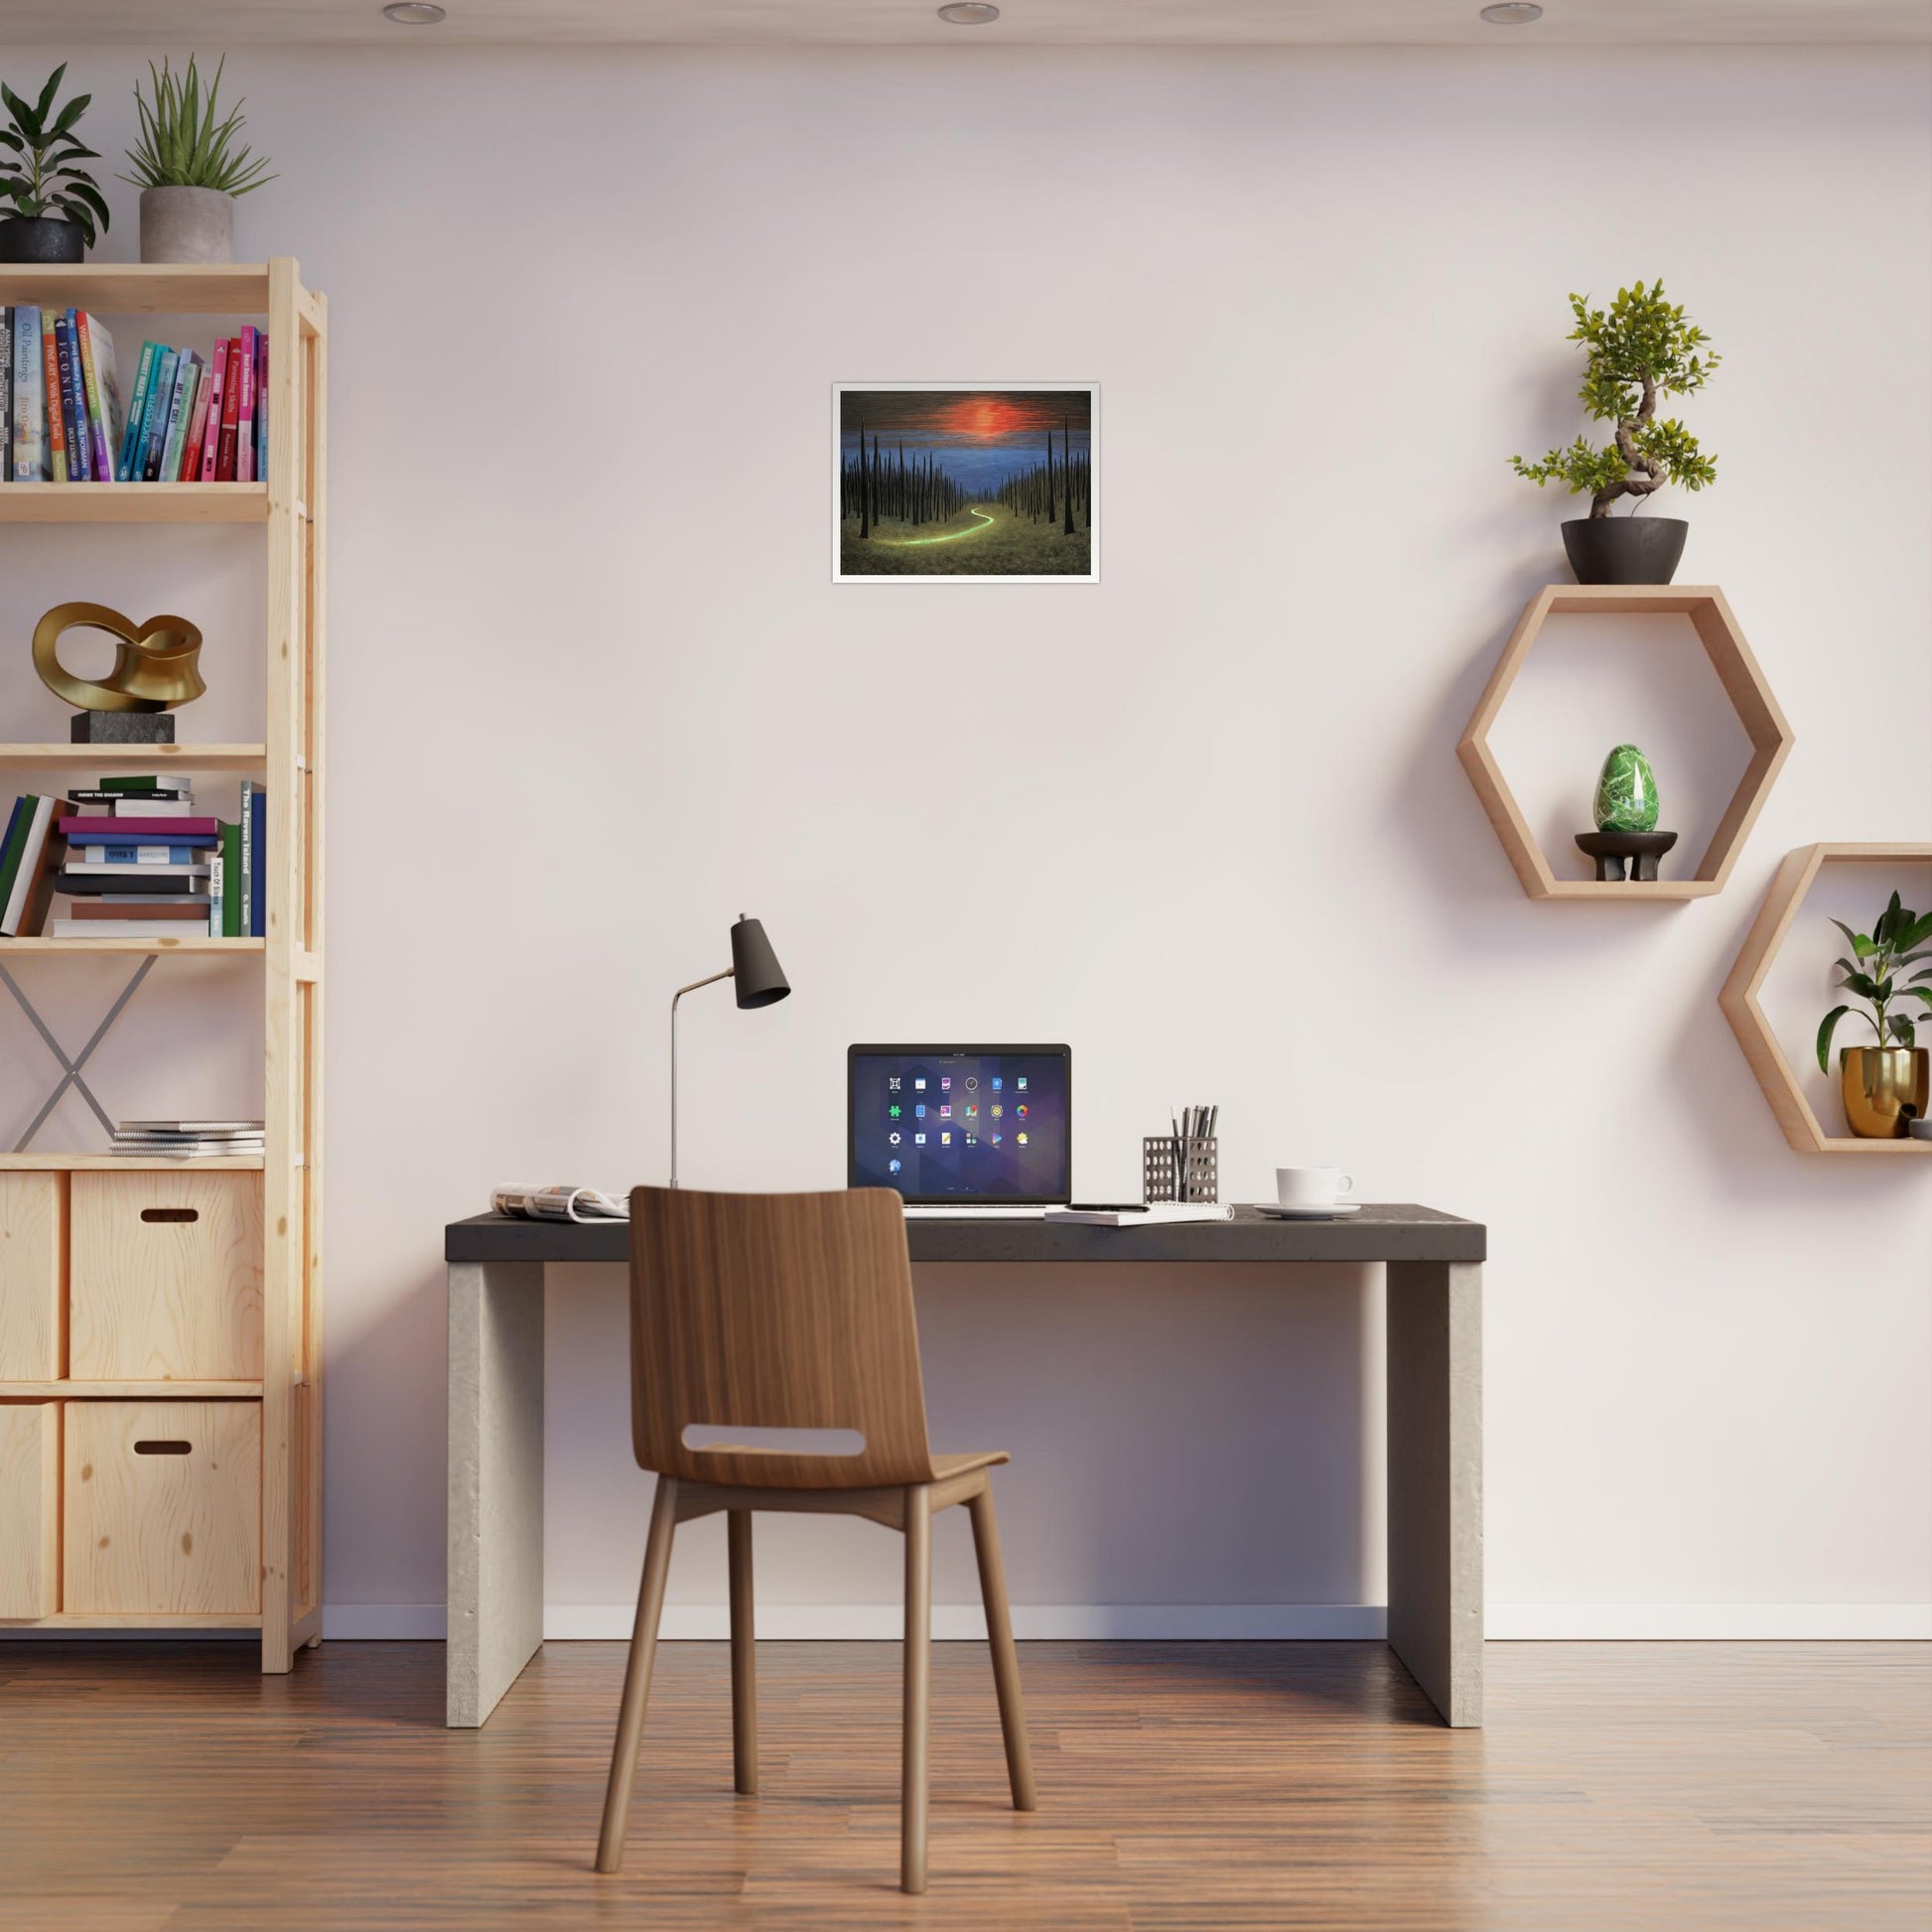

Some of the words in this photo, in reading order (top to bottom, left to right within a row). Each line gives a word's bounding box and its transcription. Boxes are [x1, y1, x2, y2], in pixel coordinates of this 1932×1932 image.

[21, 323, 33, 338] Oil
[19, 340, 32, 383] Paintings
[47, 345, 56, 361] FINE
[48, 361, 57, 376] ART
[71, 356, 81, 381] Beauty
[78, 324, 92, 371] Watercolor
[86, 372, 97, 409] Portraits
[228, 360, 239, 393] Parenting
[49, 382, 59, 399] With
[176, 382, 185, 395] ART
[74, 391, 83, 406] ART
[227, 394, 236, 413] Skills
[49, 400, 60, 422] Digital
[141, 393, 157, 444] SUCCESSFUL
[170, 408, 180, 425] CATS
[52, 422, 62, 440] Tools
[78, 437, 88, 469] NORMAN
[212, 862, 221, 878] Touch
[212, 886, 221, 905] Silence
